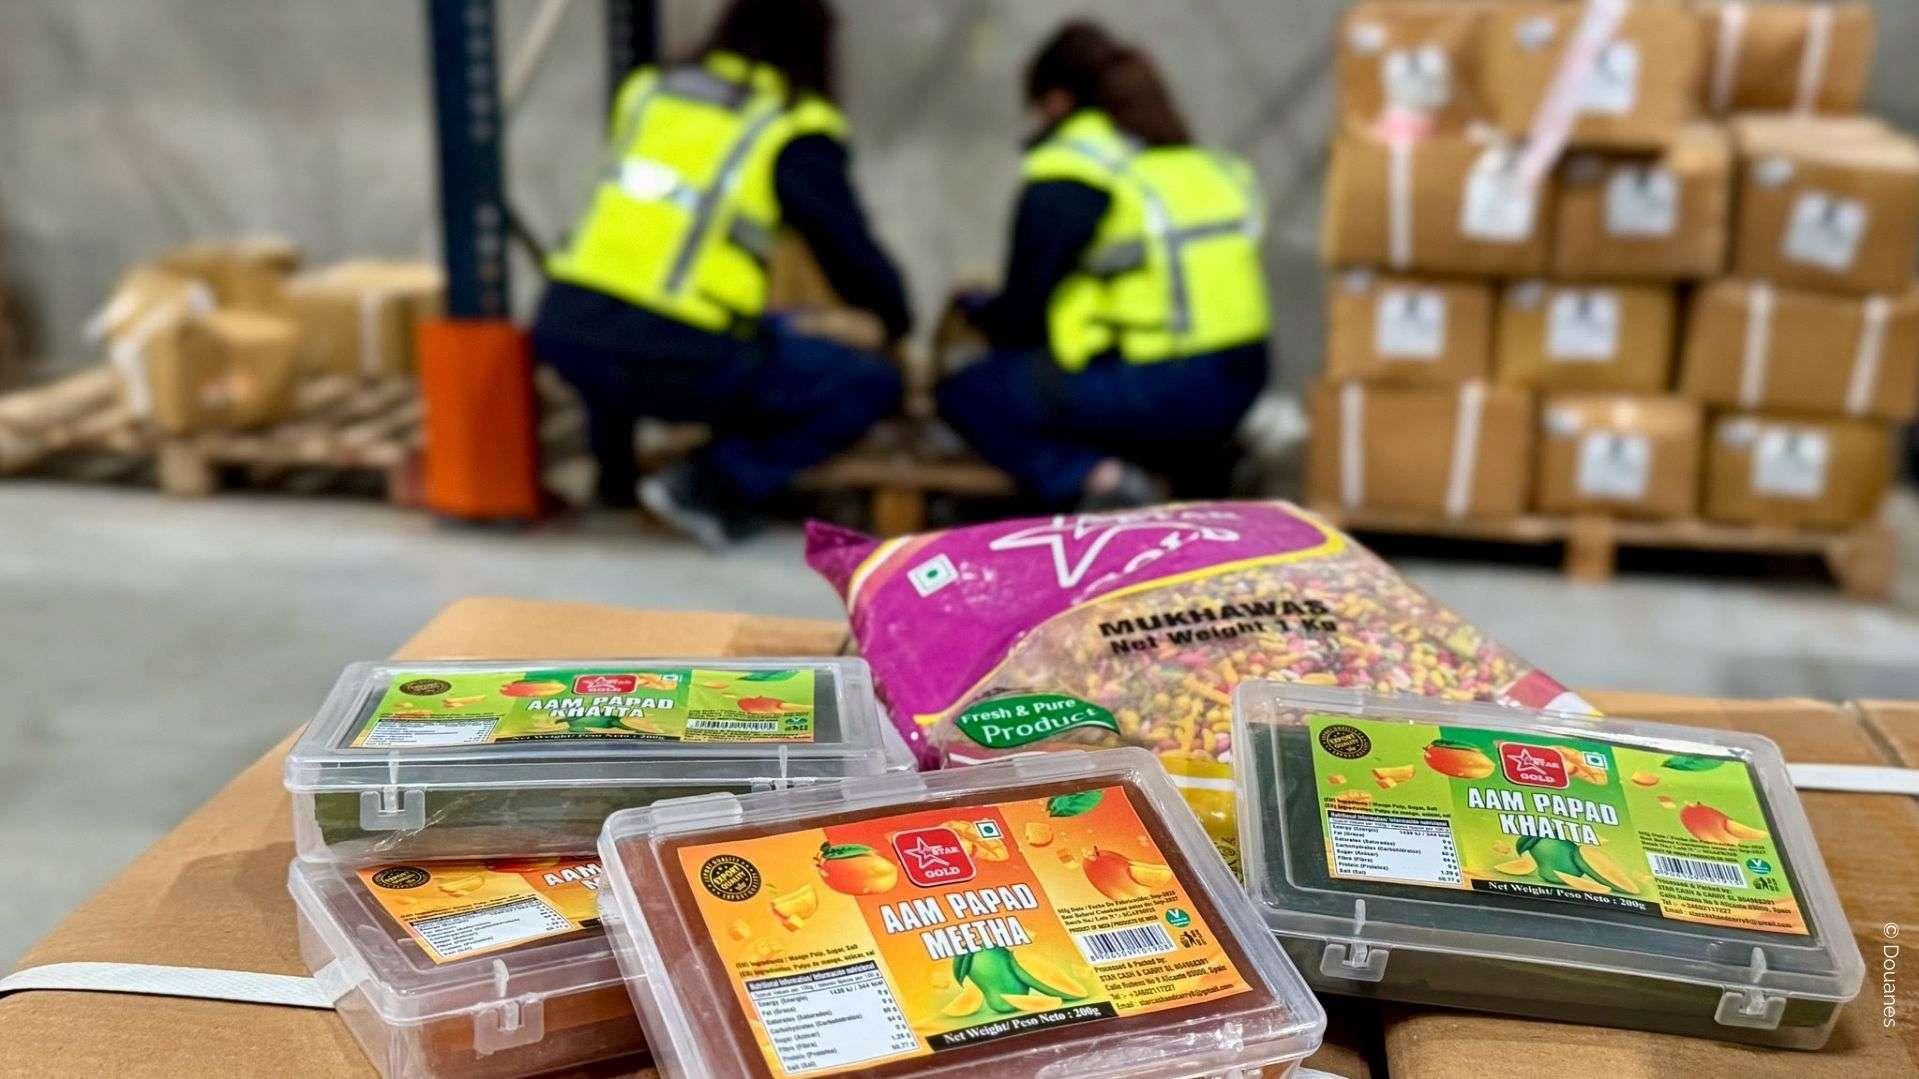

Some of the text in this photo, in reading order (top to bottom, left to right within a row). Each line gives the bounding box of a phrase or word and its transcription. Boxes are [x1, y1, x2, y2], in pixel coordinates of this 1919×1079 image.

[1099, 600, 1331, 636] MUKHAWAS
[1110, 618, 1338, 653] Net Weight 1 Kg
[528, 696, 675, 711] AAM PAPAD
[550, 706, 646, 718] KHATTA
[961, 699, 1077, 724] Fresh & Pure
[981, 708, 1098, 743] Product
[1519, 772, 1555, 782] GOLD
[1466, 787, 1618, 824] AAM PAPAD
[1499, 813, 1599, 845] KHATTA
[930, 845, 959, 855] STAR
[543, 863, 602, 887] AAM
[713, 864, 740, 885] EXPORT
[924, 866, 961, 878] GOLD
[877, 883, 1040, 933] AAM PAPAD
[1487, 881, 1507, 890] Net
[1556, 889, 1581, 899] Peso
[1583, 893, 1610, 903] Neto
[1619, 899, 1646, 910] 200g
[921, 917, 1032, 960] MEETHA
[943, 1031, 965, 1043] Net
[967, 1022, 1012, 1038] Weight/
[1012, 1016, 1039, 1028] Peso
[1039, 1011, 1066, 1023] Neto
[1073, 1005, 1101, 1019] 200g
